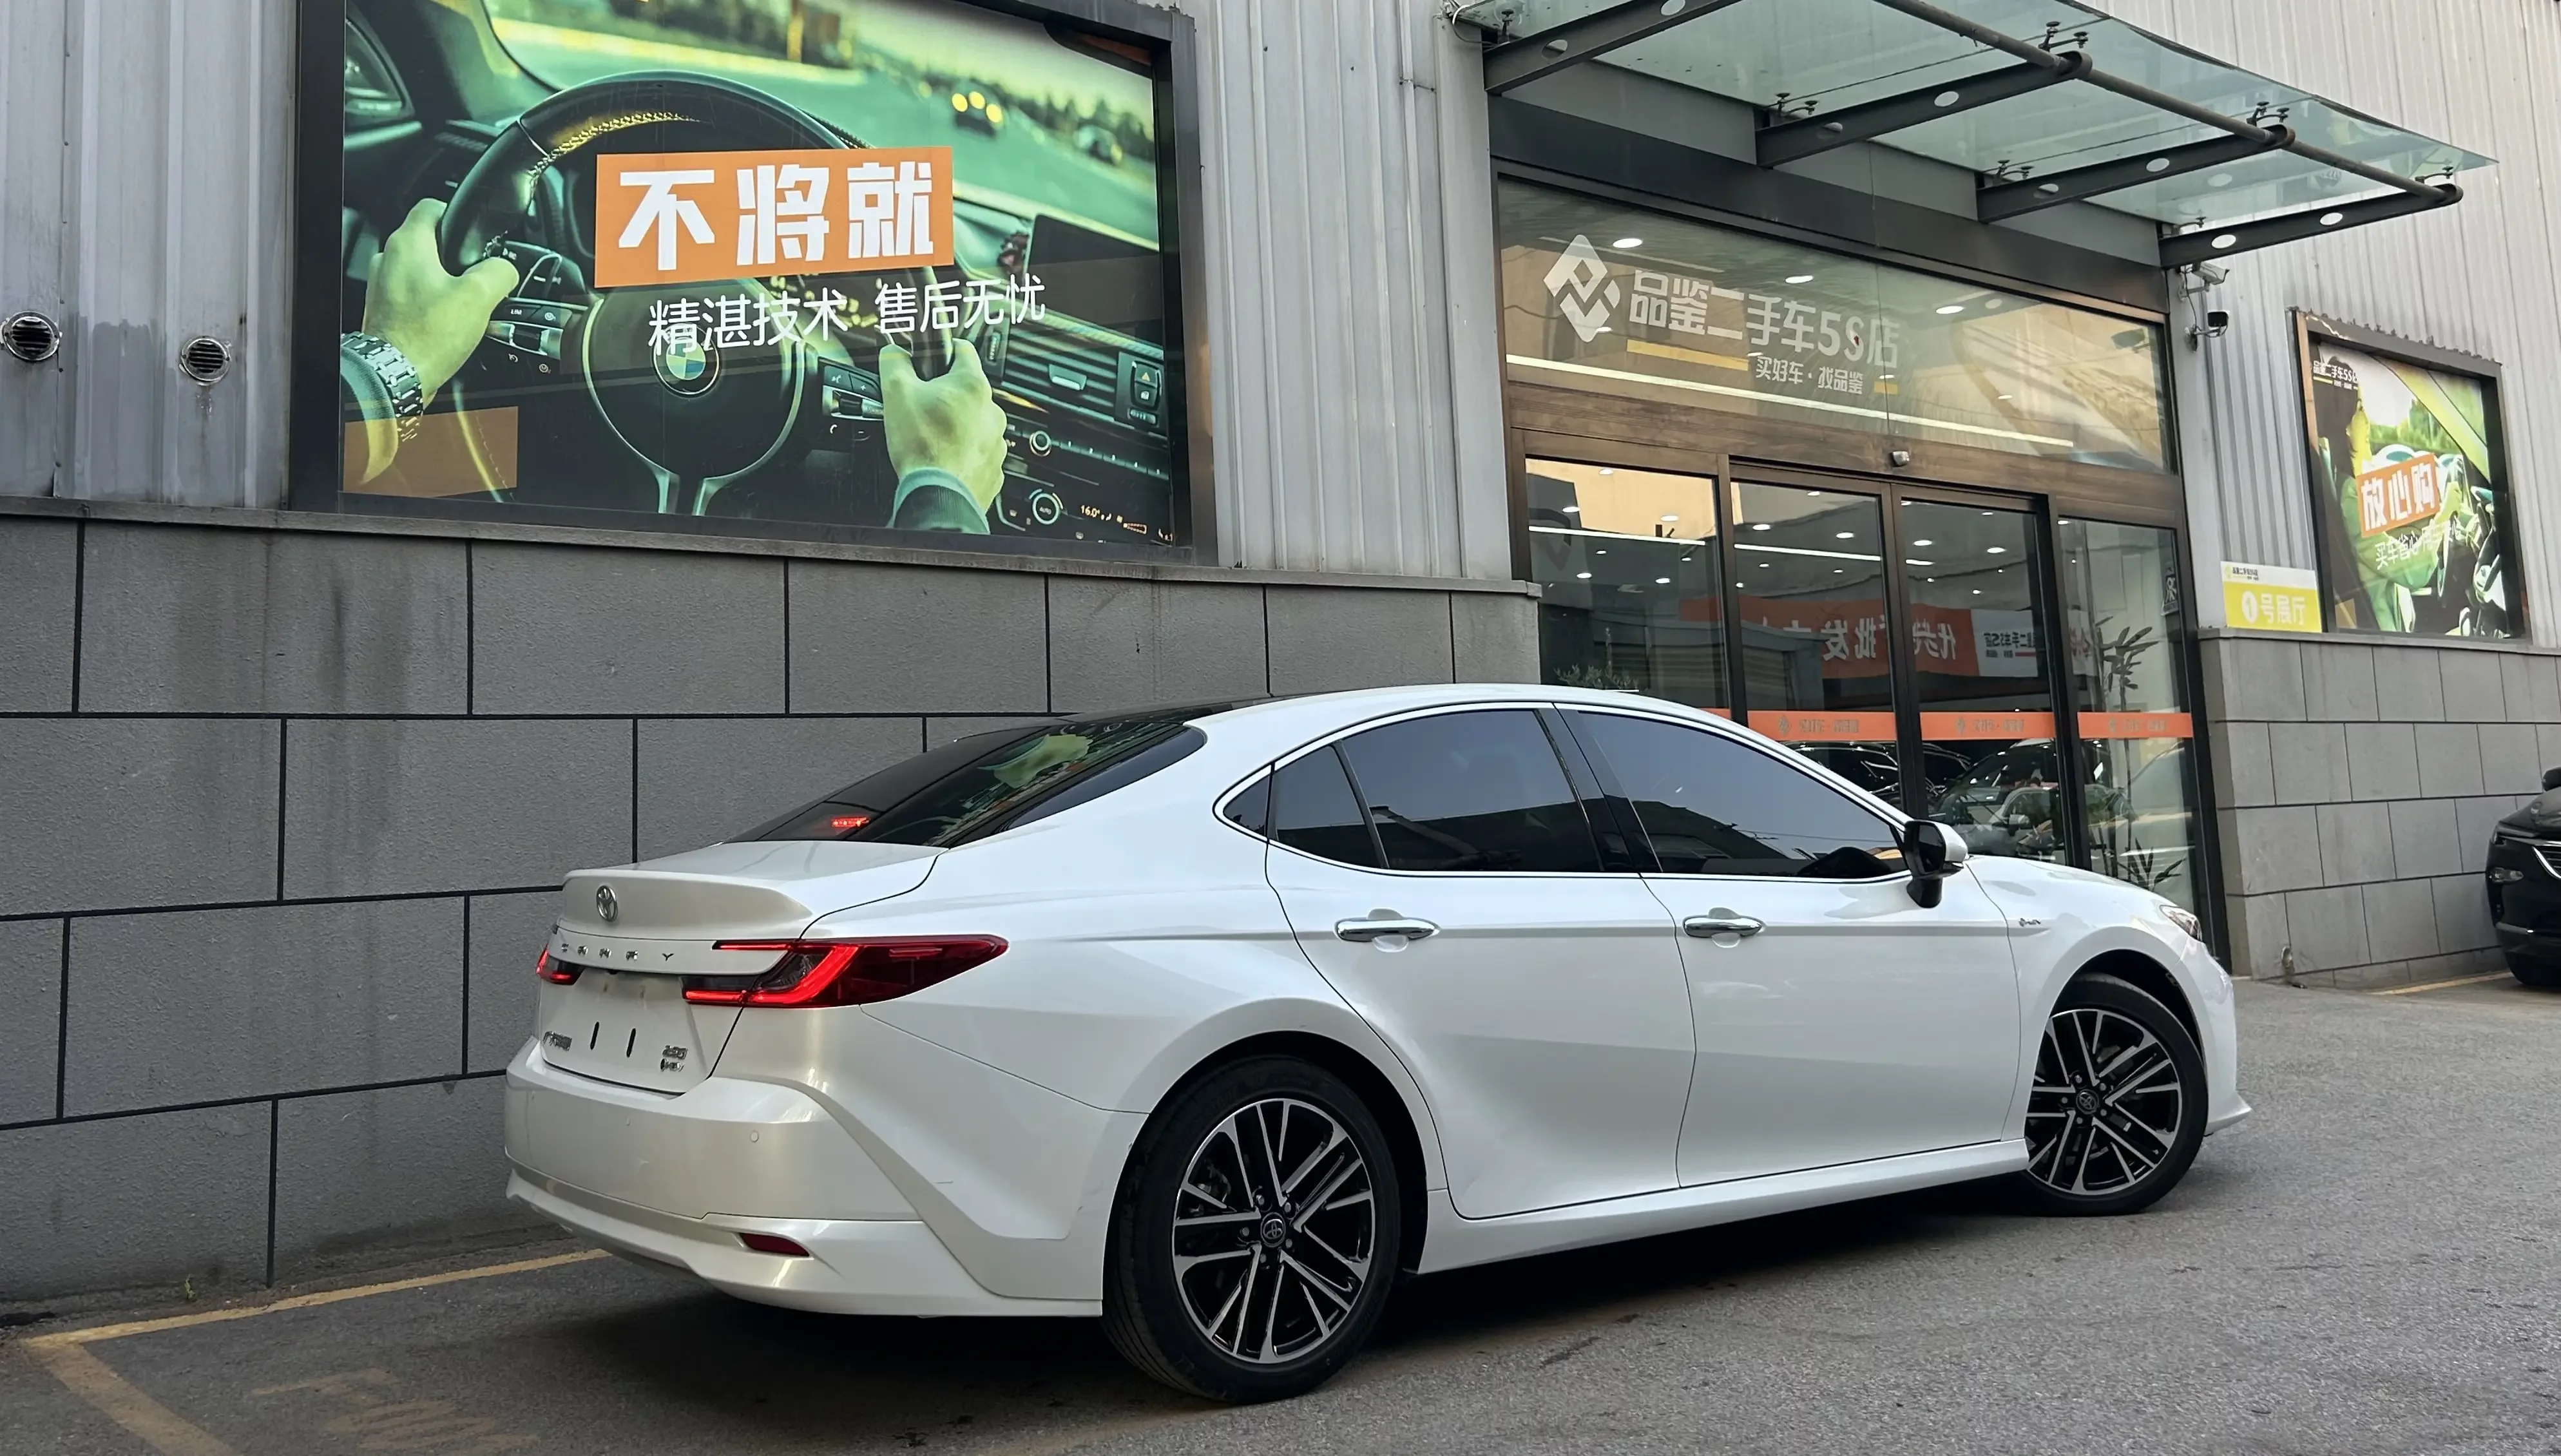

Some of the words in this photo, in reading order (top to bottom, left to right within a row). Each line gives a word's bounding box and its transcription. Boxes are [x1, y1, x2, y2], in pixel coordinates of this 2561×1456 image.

[618, 161, 934, 271] 不将就
[648, 287, 849, 356] 精湛技术
[874, 273, 1046, 336] 售后无忧
[1629, 269, 1901, 369] 品鉴二手车5S店
[2361, 463, 2435, 531] 放心购
